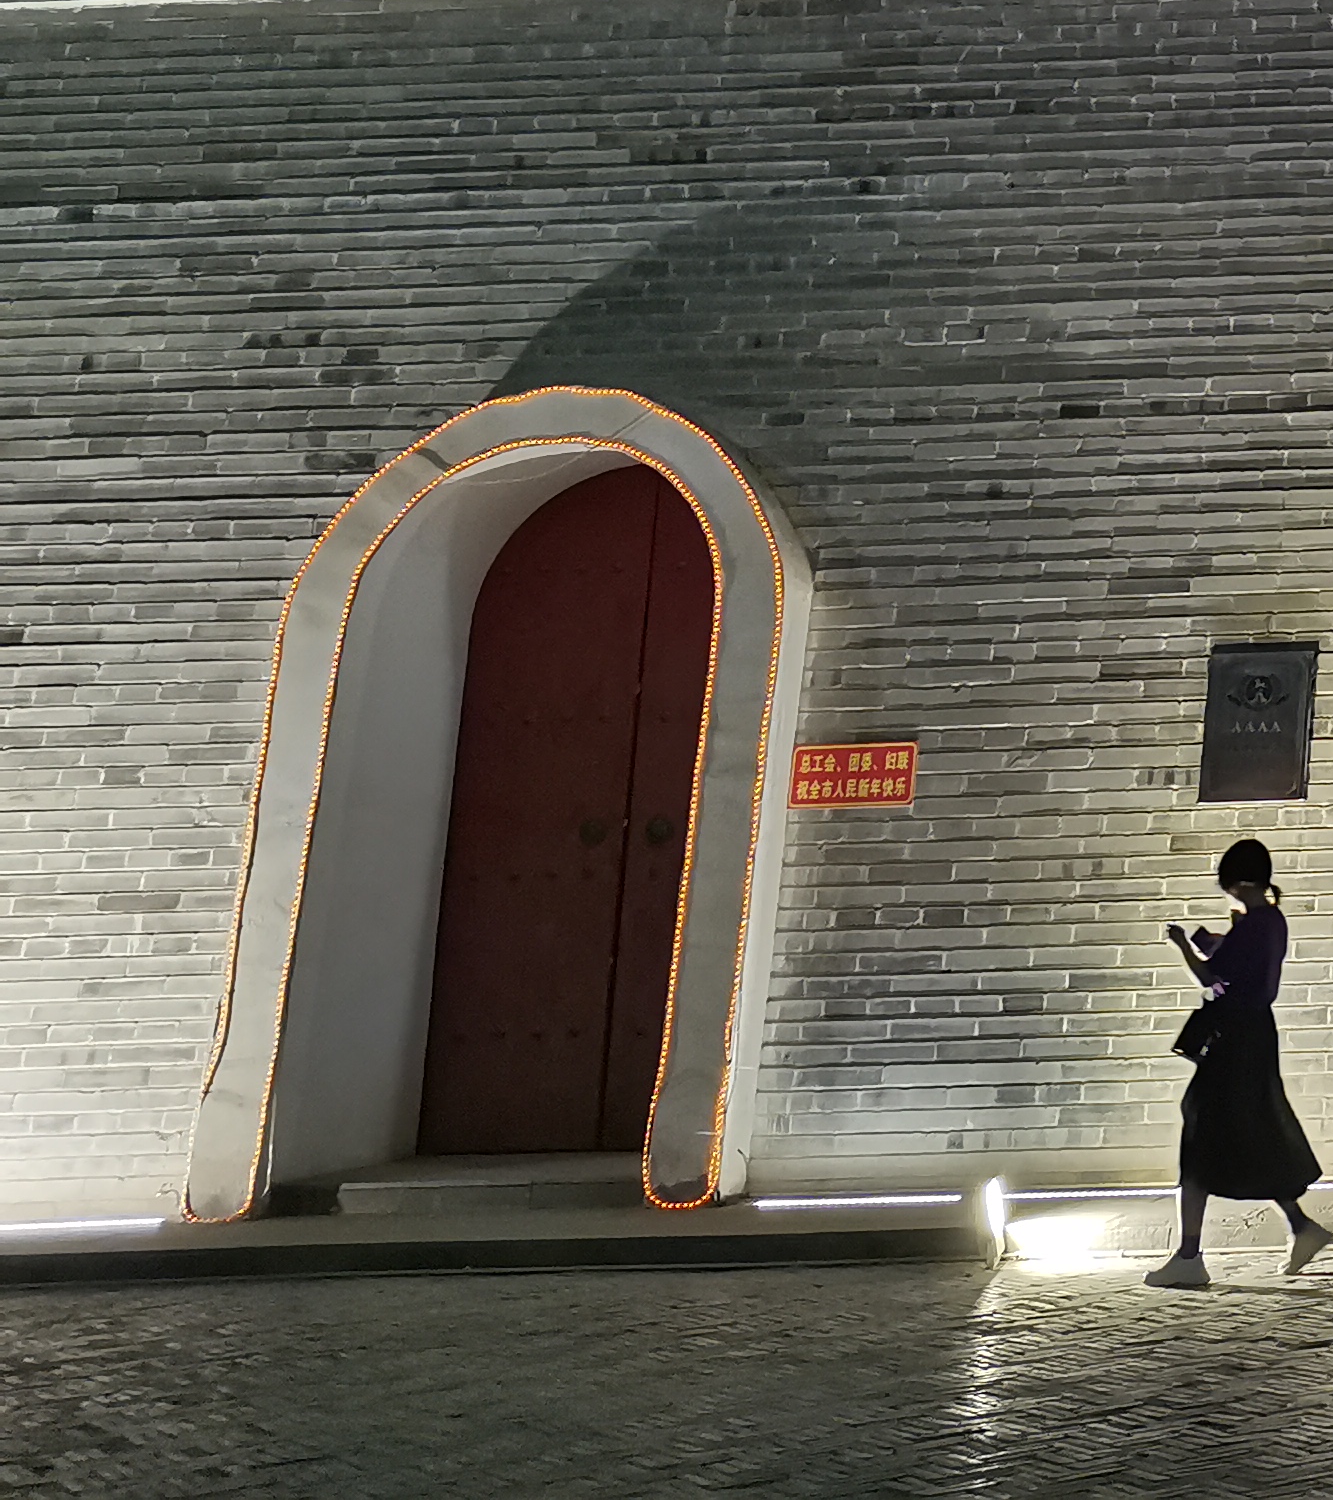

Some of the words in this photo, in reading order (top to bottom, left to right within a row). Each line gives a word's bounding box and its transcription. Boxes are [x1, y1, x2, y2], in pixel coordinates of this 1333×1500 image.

[796, 777, 906, 800] 祝全市人民新年快乐
